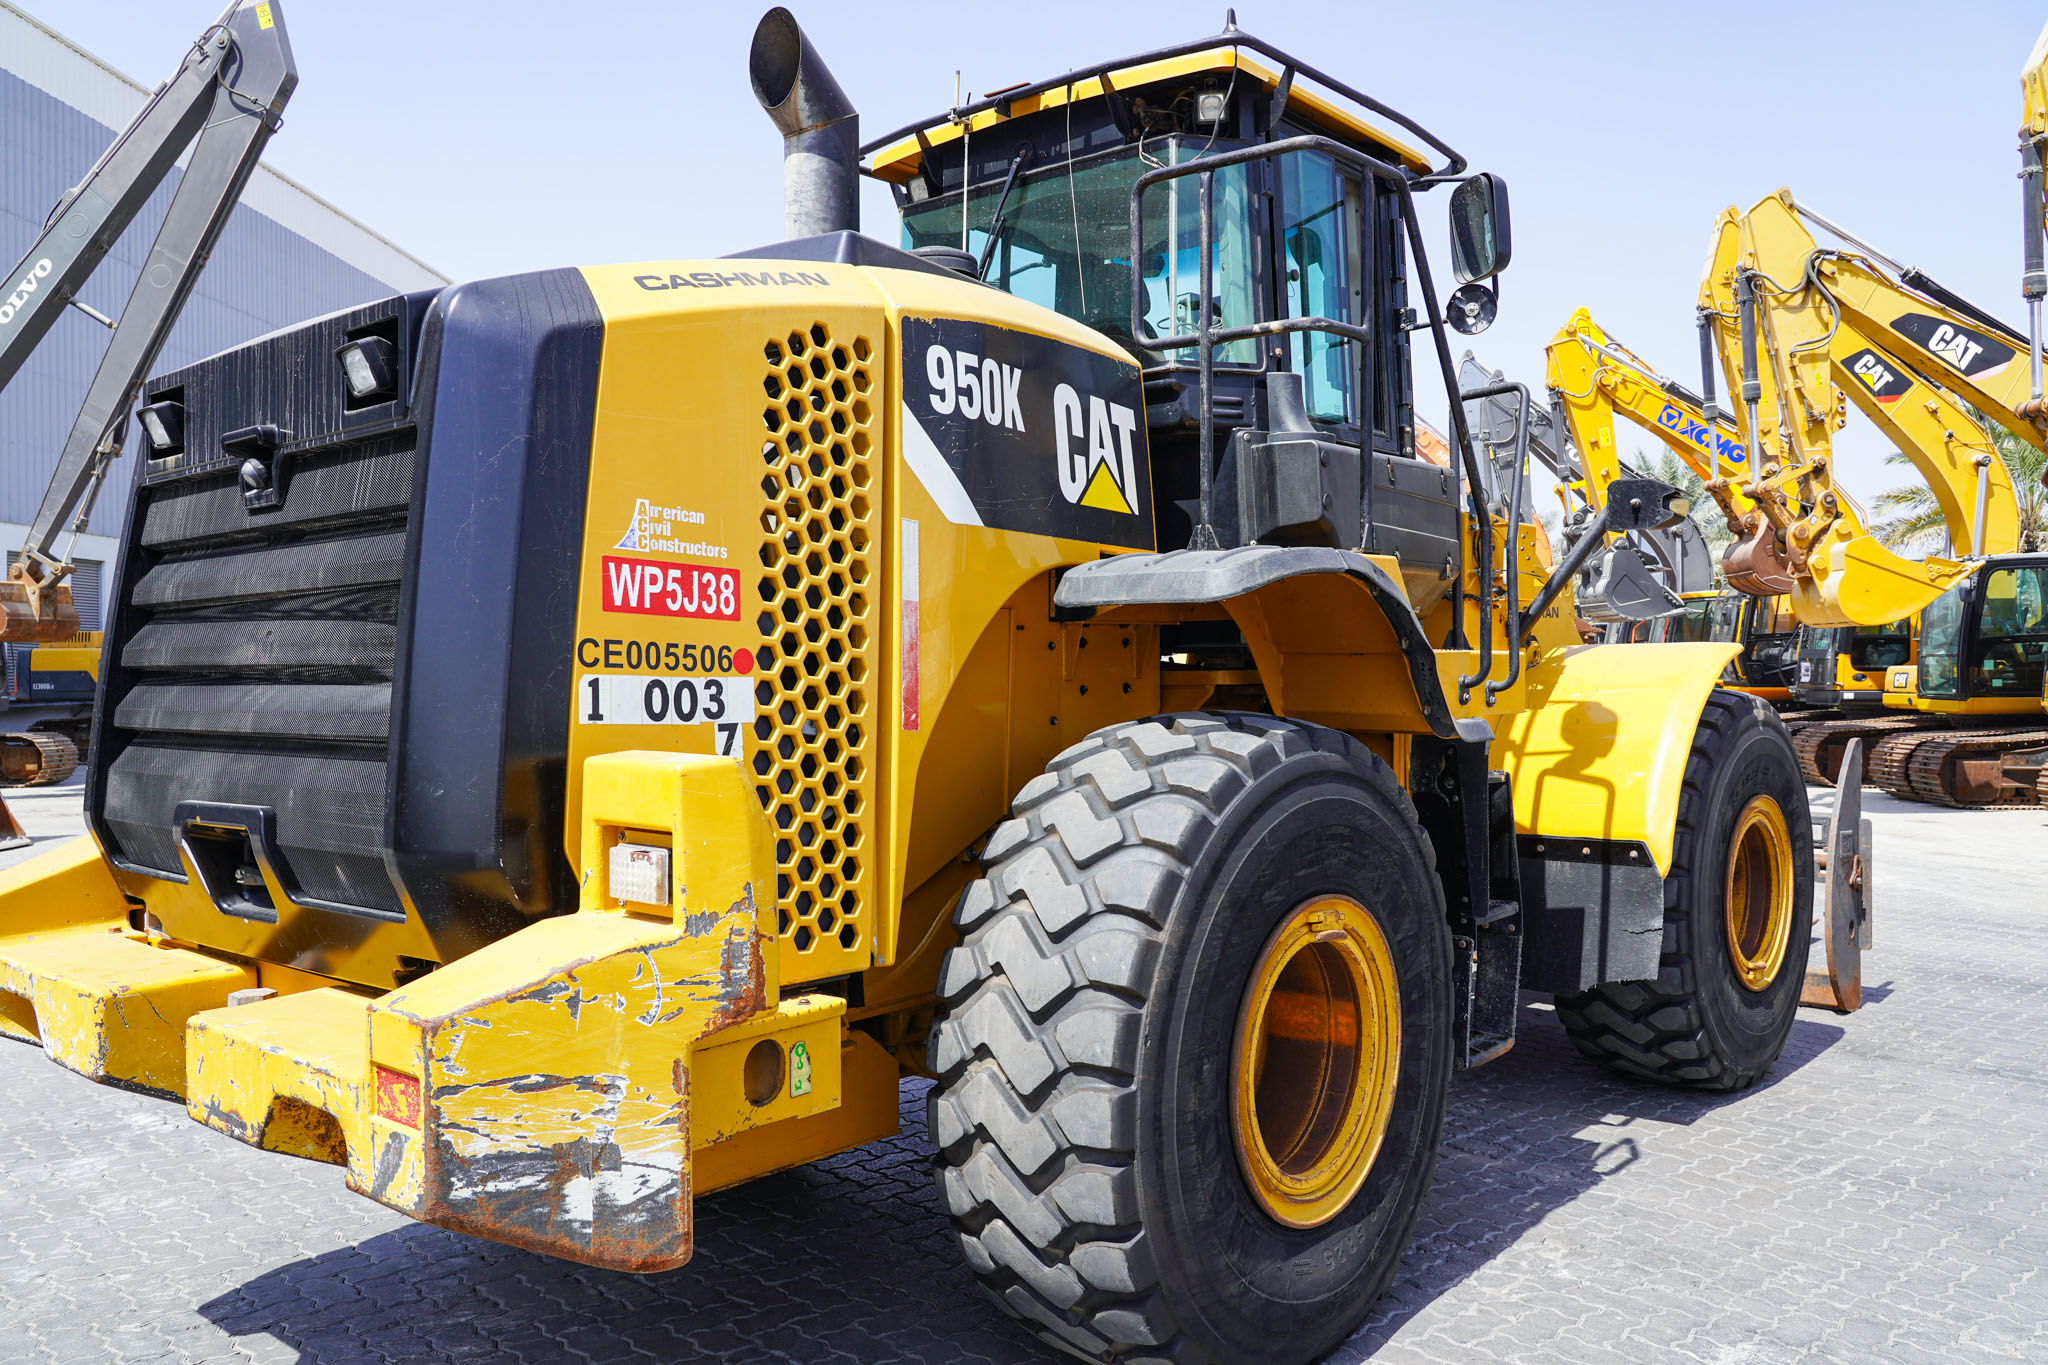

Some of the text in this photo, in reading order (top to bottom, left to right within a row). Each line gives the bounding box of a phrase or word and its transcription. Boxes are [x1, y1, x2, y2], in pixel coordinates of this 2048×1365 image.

[633, 271, 831, 291] CASHMAN
[1928, 324, 1984, 371] CAT
[926, 344, 1026, 433] 950K
[1853, 354, 1895, 392] CAT
[1053, 382, 1140, 516] CAT
[1676, 417, 1748, 463] XCMG
[637, 500, 705, 525] American
[637, 518, 672, 537] Civil
[637, 533, 728, 560] Constructors
[608, 562, 736, 616] WP5J38
[577, 637, 733, 673] CE005506
[1893, 673, 1908, 688] CAT
[717, 722, 739, 757] 7
